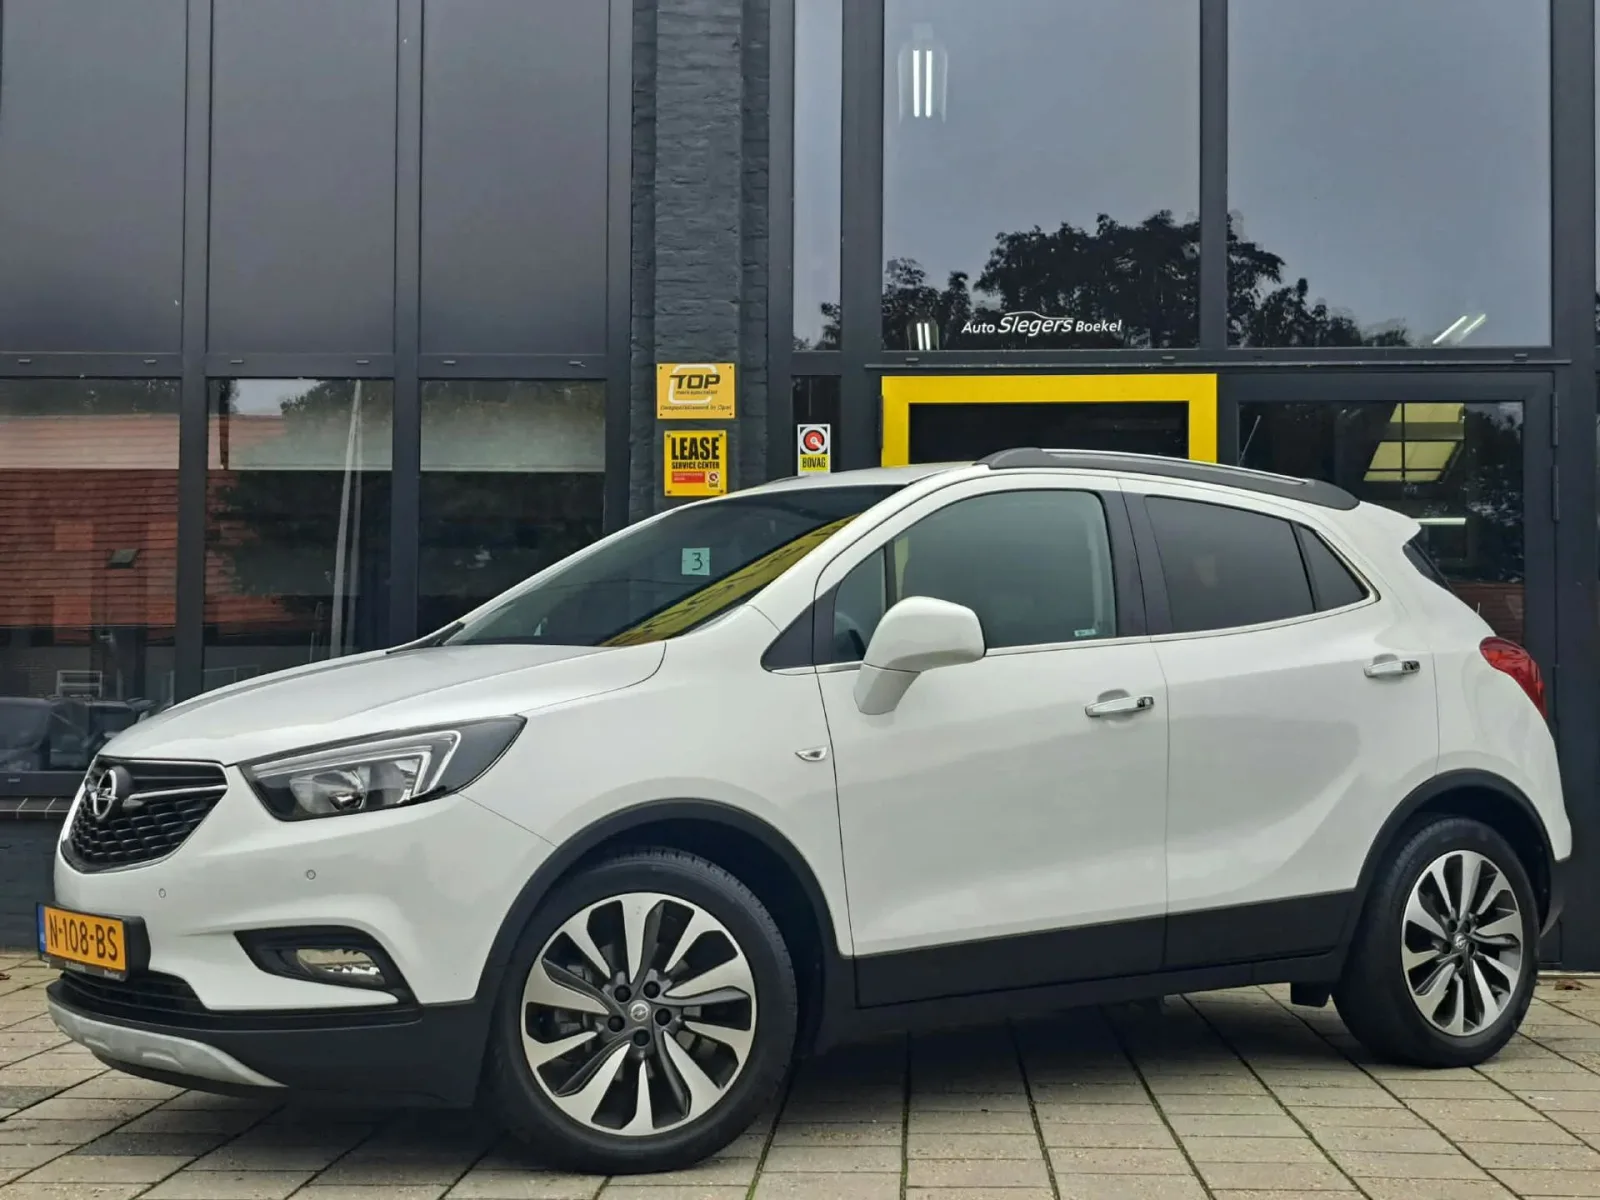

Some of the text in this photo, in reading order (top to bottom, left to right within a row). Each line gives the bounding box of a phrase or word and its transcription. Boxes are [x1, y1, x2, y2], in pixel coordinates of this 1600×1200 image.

[961, 315, 1122, 337] Auto Slegers Boekel
[669, 374, 721, 389] TOP
[671, 436, 720, 460] LEASE
[671, 461, 720, 469] SERVICE CENTER
[802, 457, 826, 468] BOVAG
[691, 552, 703, 571] 3
[48, 913, 118, 962] N-108-BS
